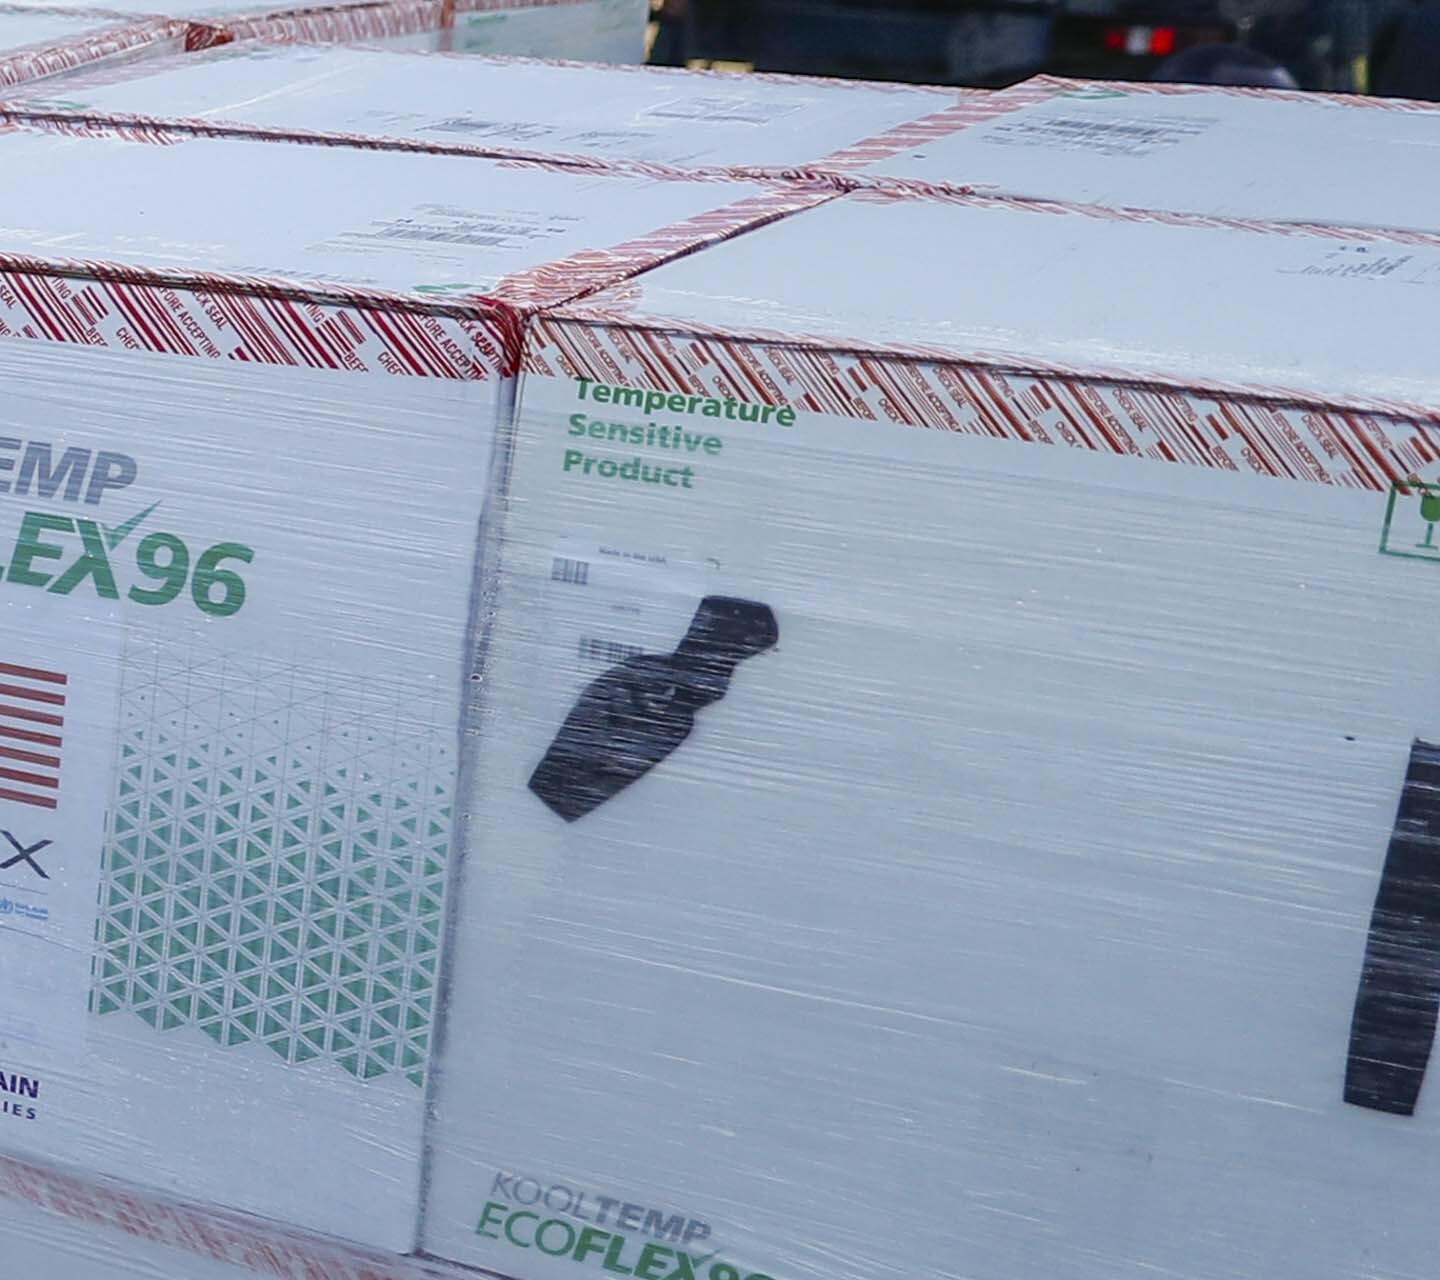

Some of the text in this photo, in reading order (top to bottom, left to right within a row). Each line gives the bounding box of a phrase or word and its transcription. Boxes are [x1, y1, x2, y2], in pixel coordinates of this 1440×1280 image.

[573, 376, 798, 429] Temperature
[567, 412, 725, 459] Sensitive
[561, 448, 697, 492] Product
[488, 1169, 713, 1247] KOOLTEMP
